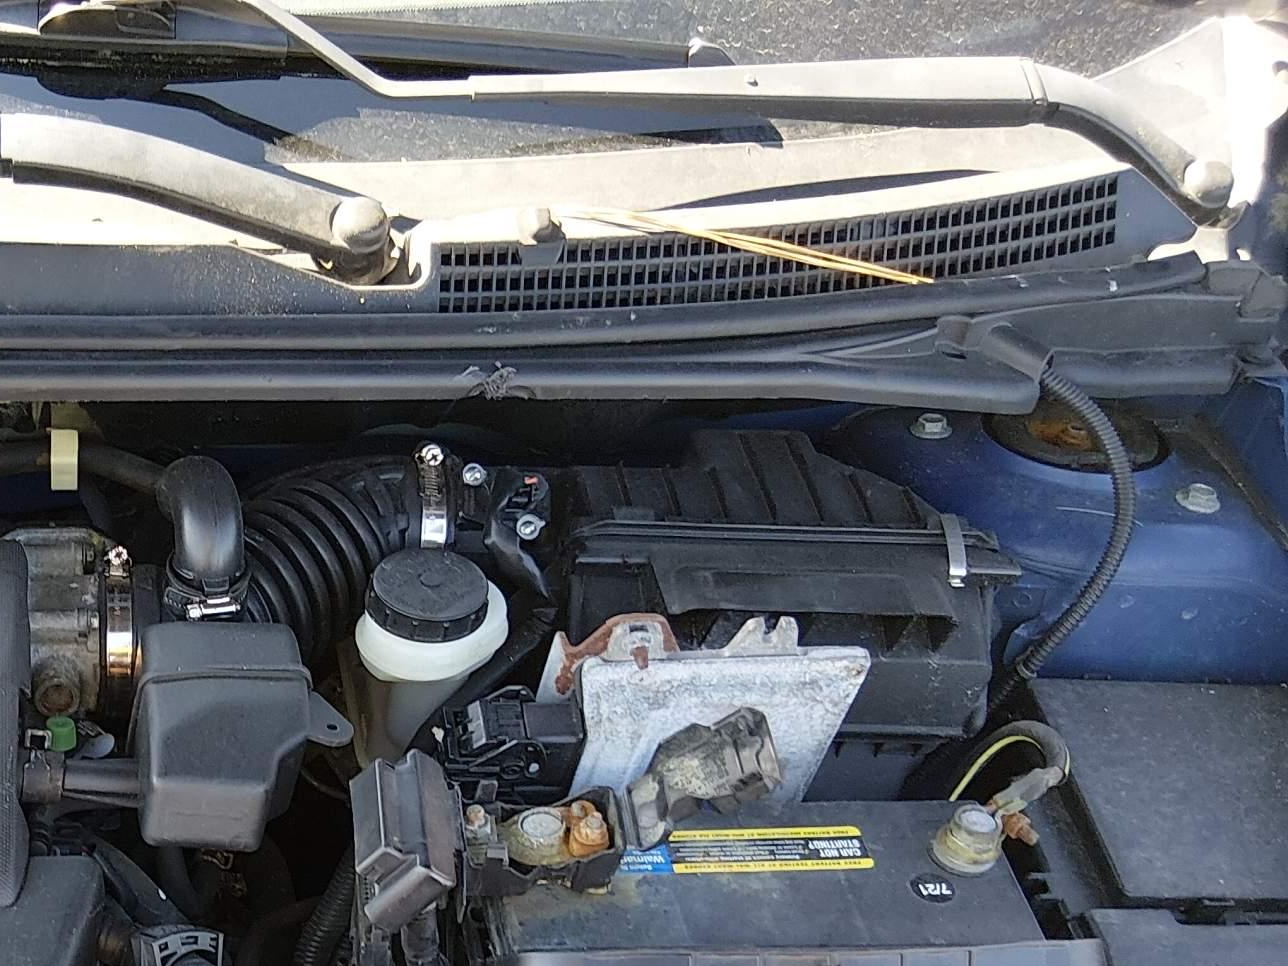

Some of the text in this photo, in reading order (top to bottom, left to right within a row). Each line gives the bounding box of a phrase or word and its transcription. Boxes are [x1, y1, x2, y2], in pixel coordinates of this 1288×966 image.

[807, 838, 861, 850] STARTING?
[819, 847, 861, 858] CAR NOT
[917, 882, 953, 897] 7/21
